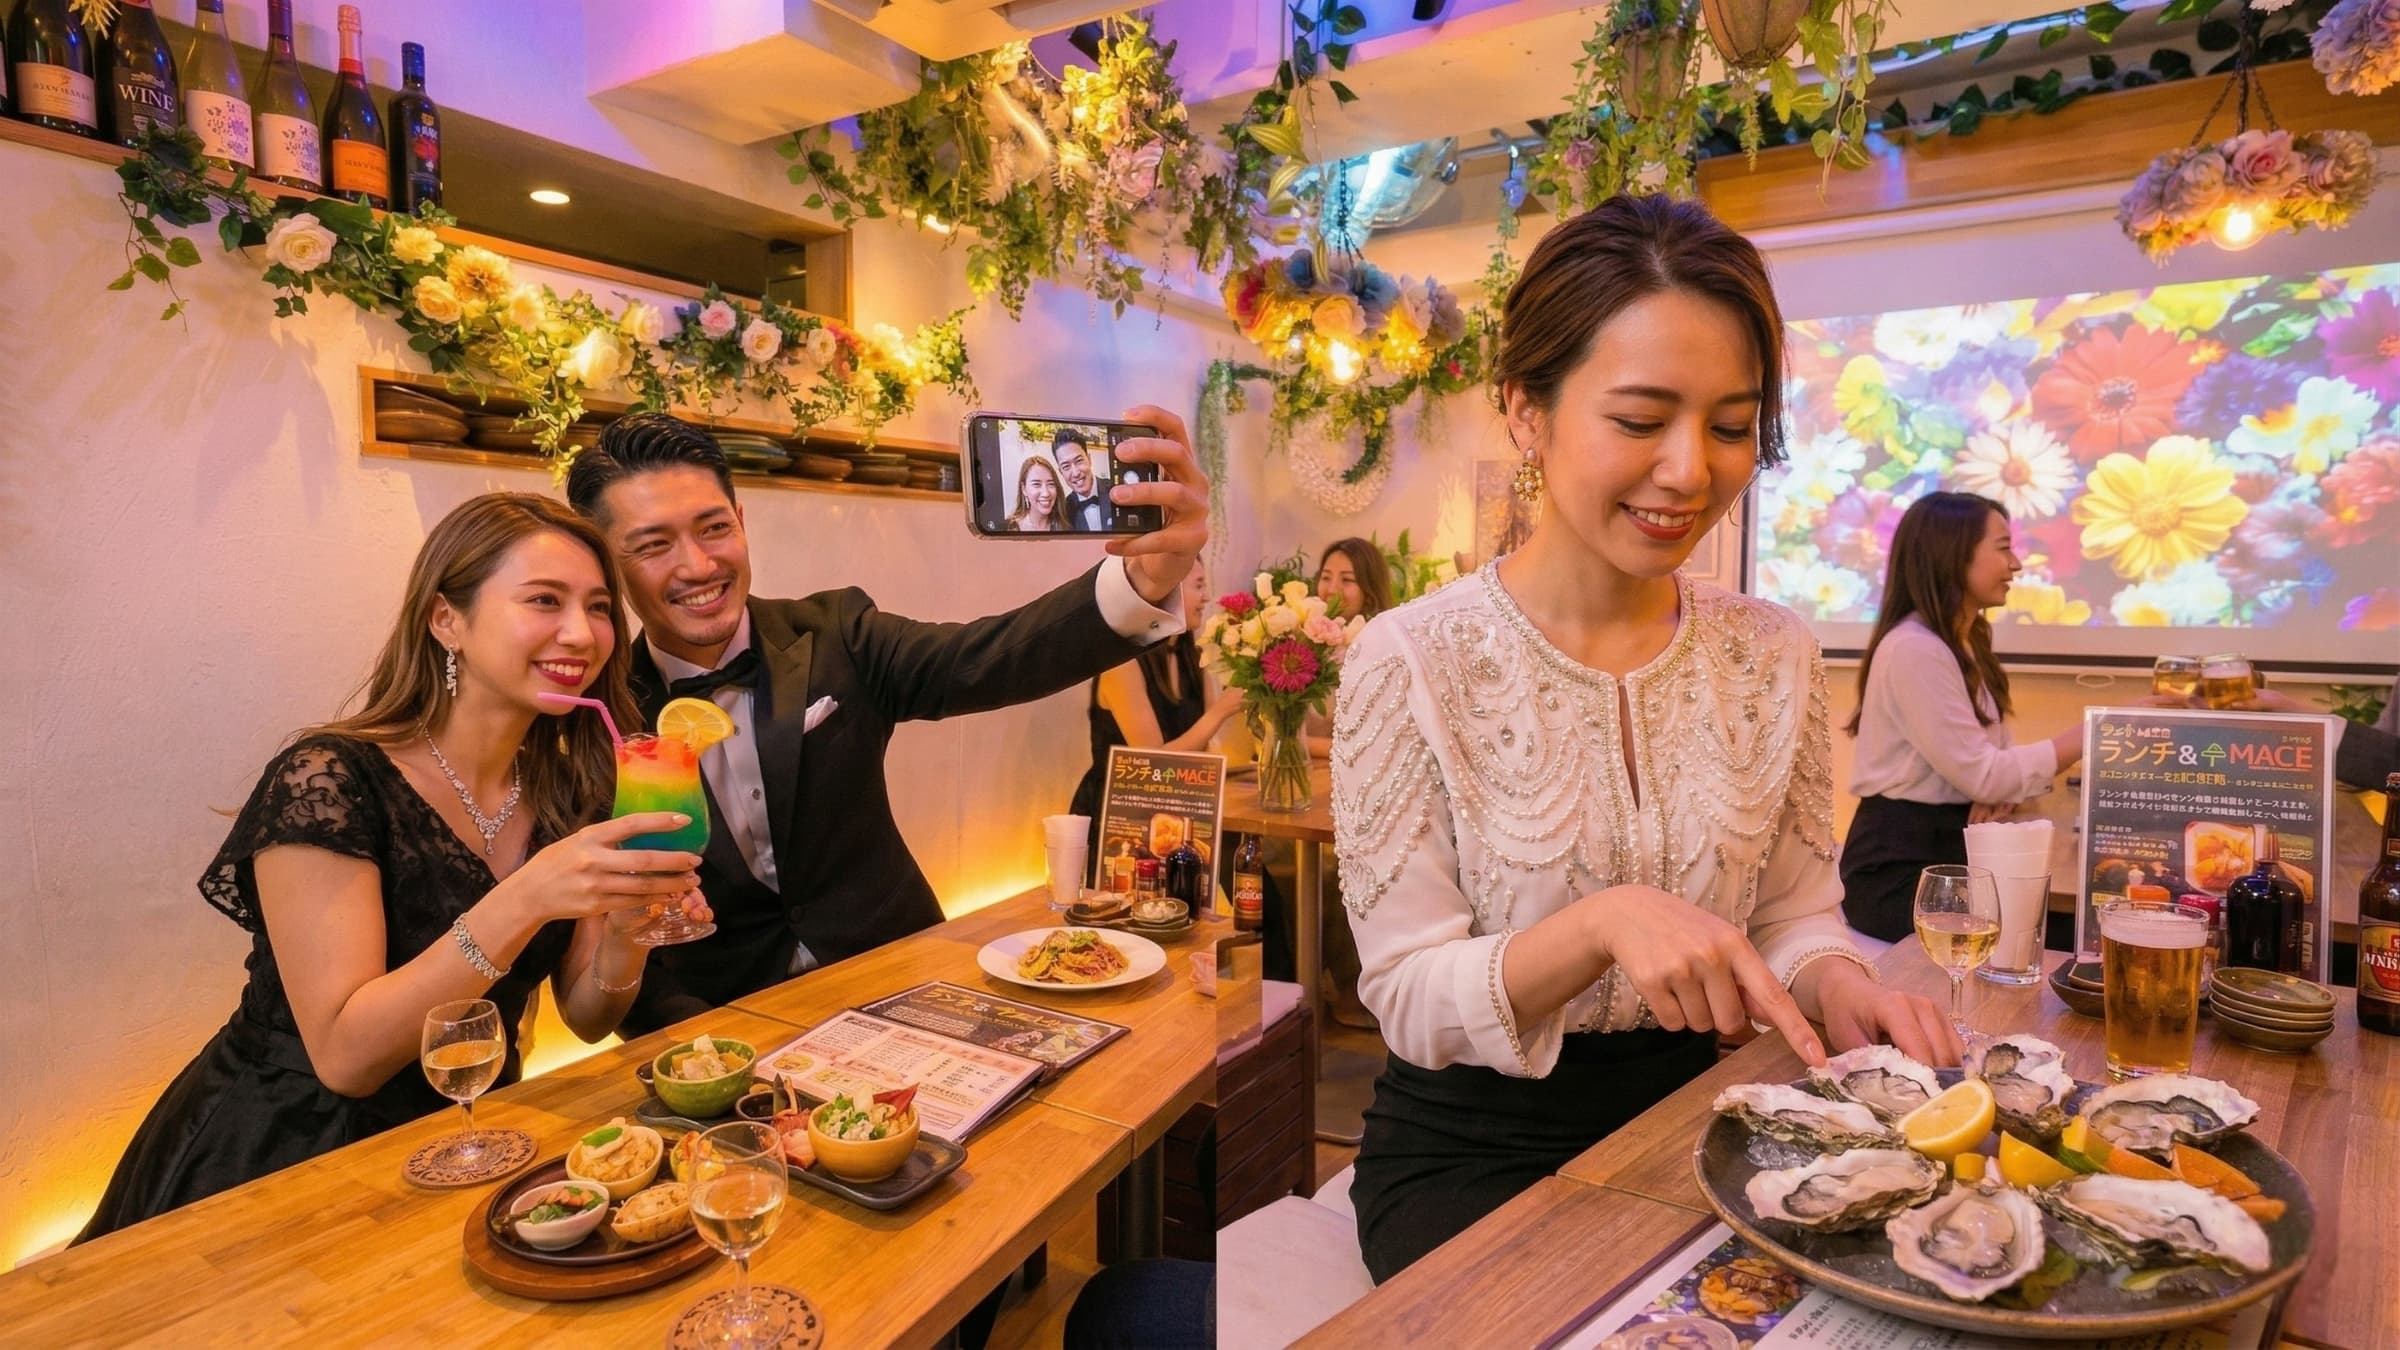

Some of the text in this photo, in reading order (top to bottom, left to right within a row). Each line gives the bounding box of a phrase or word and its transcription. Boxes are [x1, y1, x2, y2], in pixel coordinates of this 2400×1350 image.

[119, 83, 175, 113] WINE
[2099, 740, 2313, 769] ランチ & MACE
[1176, 767, 1217, 784] MACE
